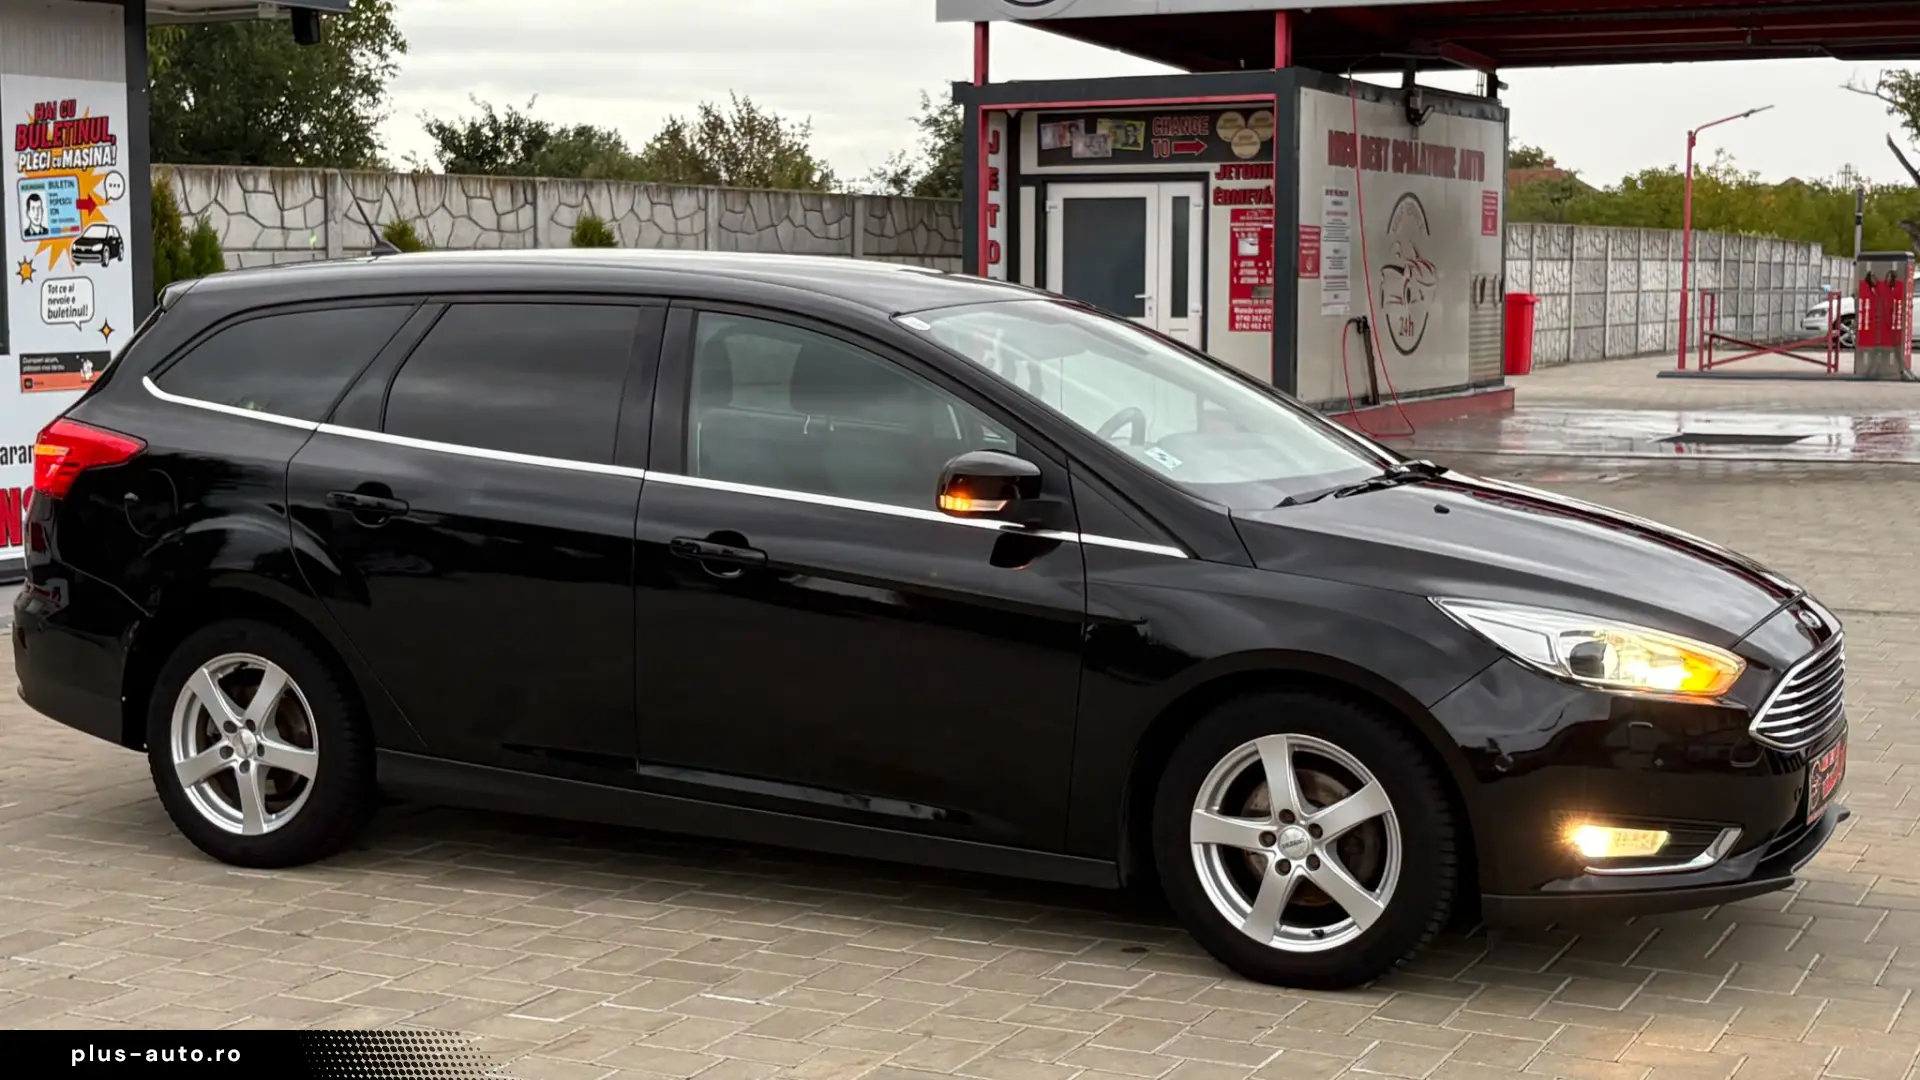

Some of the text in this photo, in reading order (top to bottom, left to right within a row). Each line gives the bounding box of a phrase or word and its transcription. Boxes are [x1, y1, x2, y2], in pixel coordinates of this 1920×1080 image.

[34, 99, 77, 121] HAI CU
[15, 116, 117, 152] BULETINUL,
[1152, 116, 1210, 136] CHANGE
[1151, 138, 1170, 158] TO
[18, 150, 52, 173] PLECI
[62, 145, 117, 172] MAȘINA!
[987, 129, 1001, 280] JETO
[47, 281, 75, 294] Tot ce ai
[47, 295, 76, 305] nevoie e
[47, 304, 89, 320] buletinul!
[1399, 313, 1414, 337] 24h
